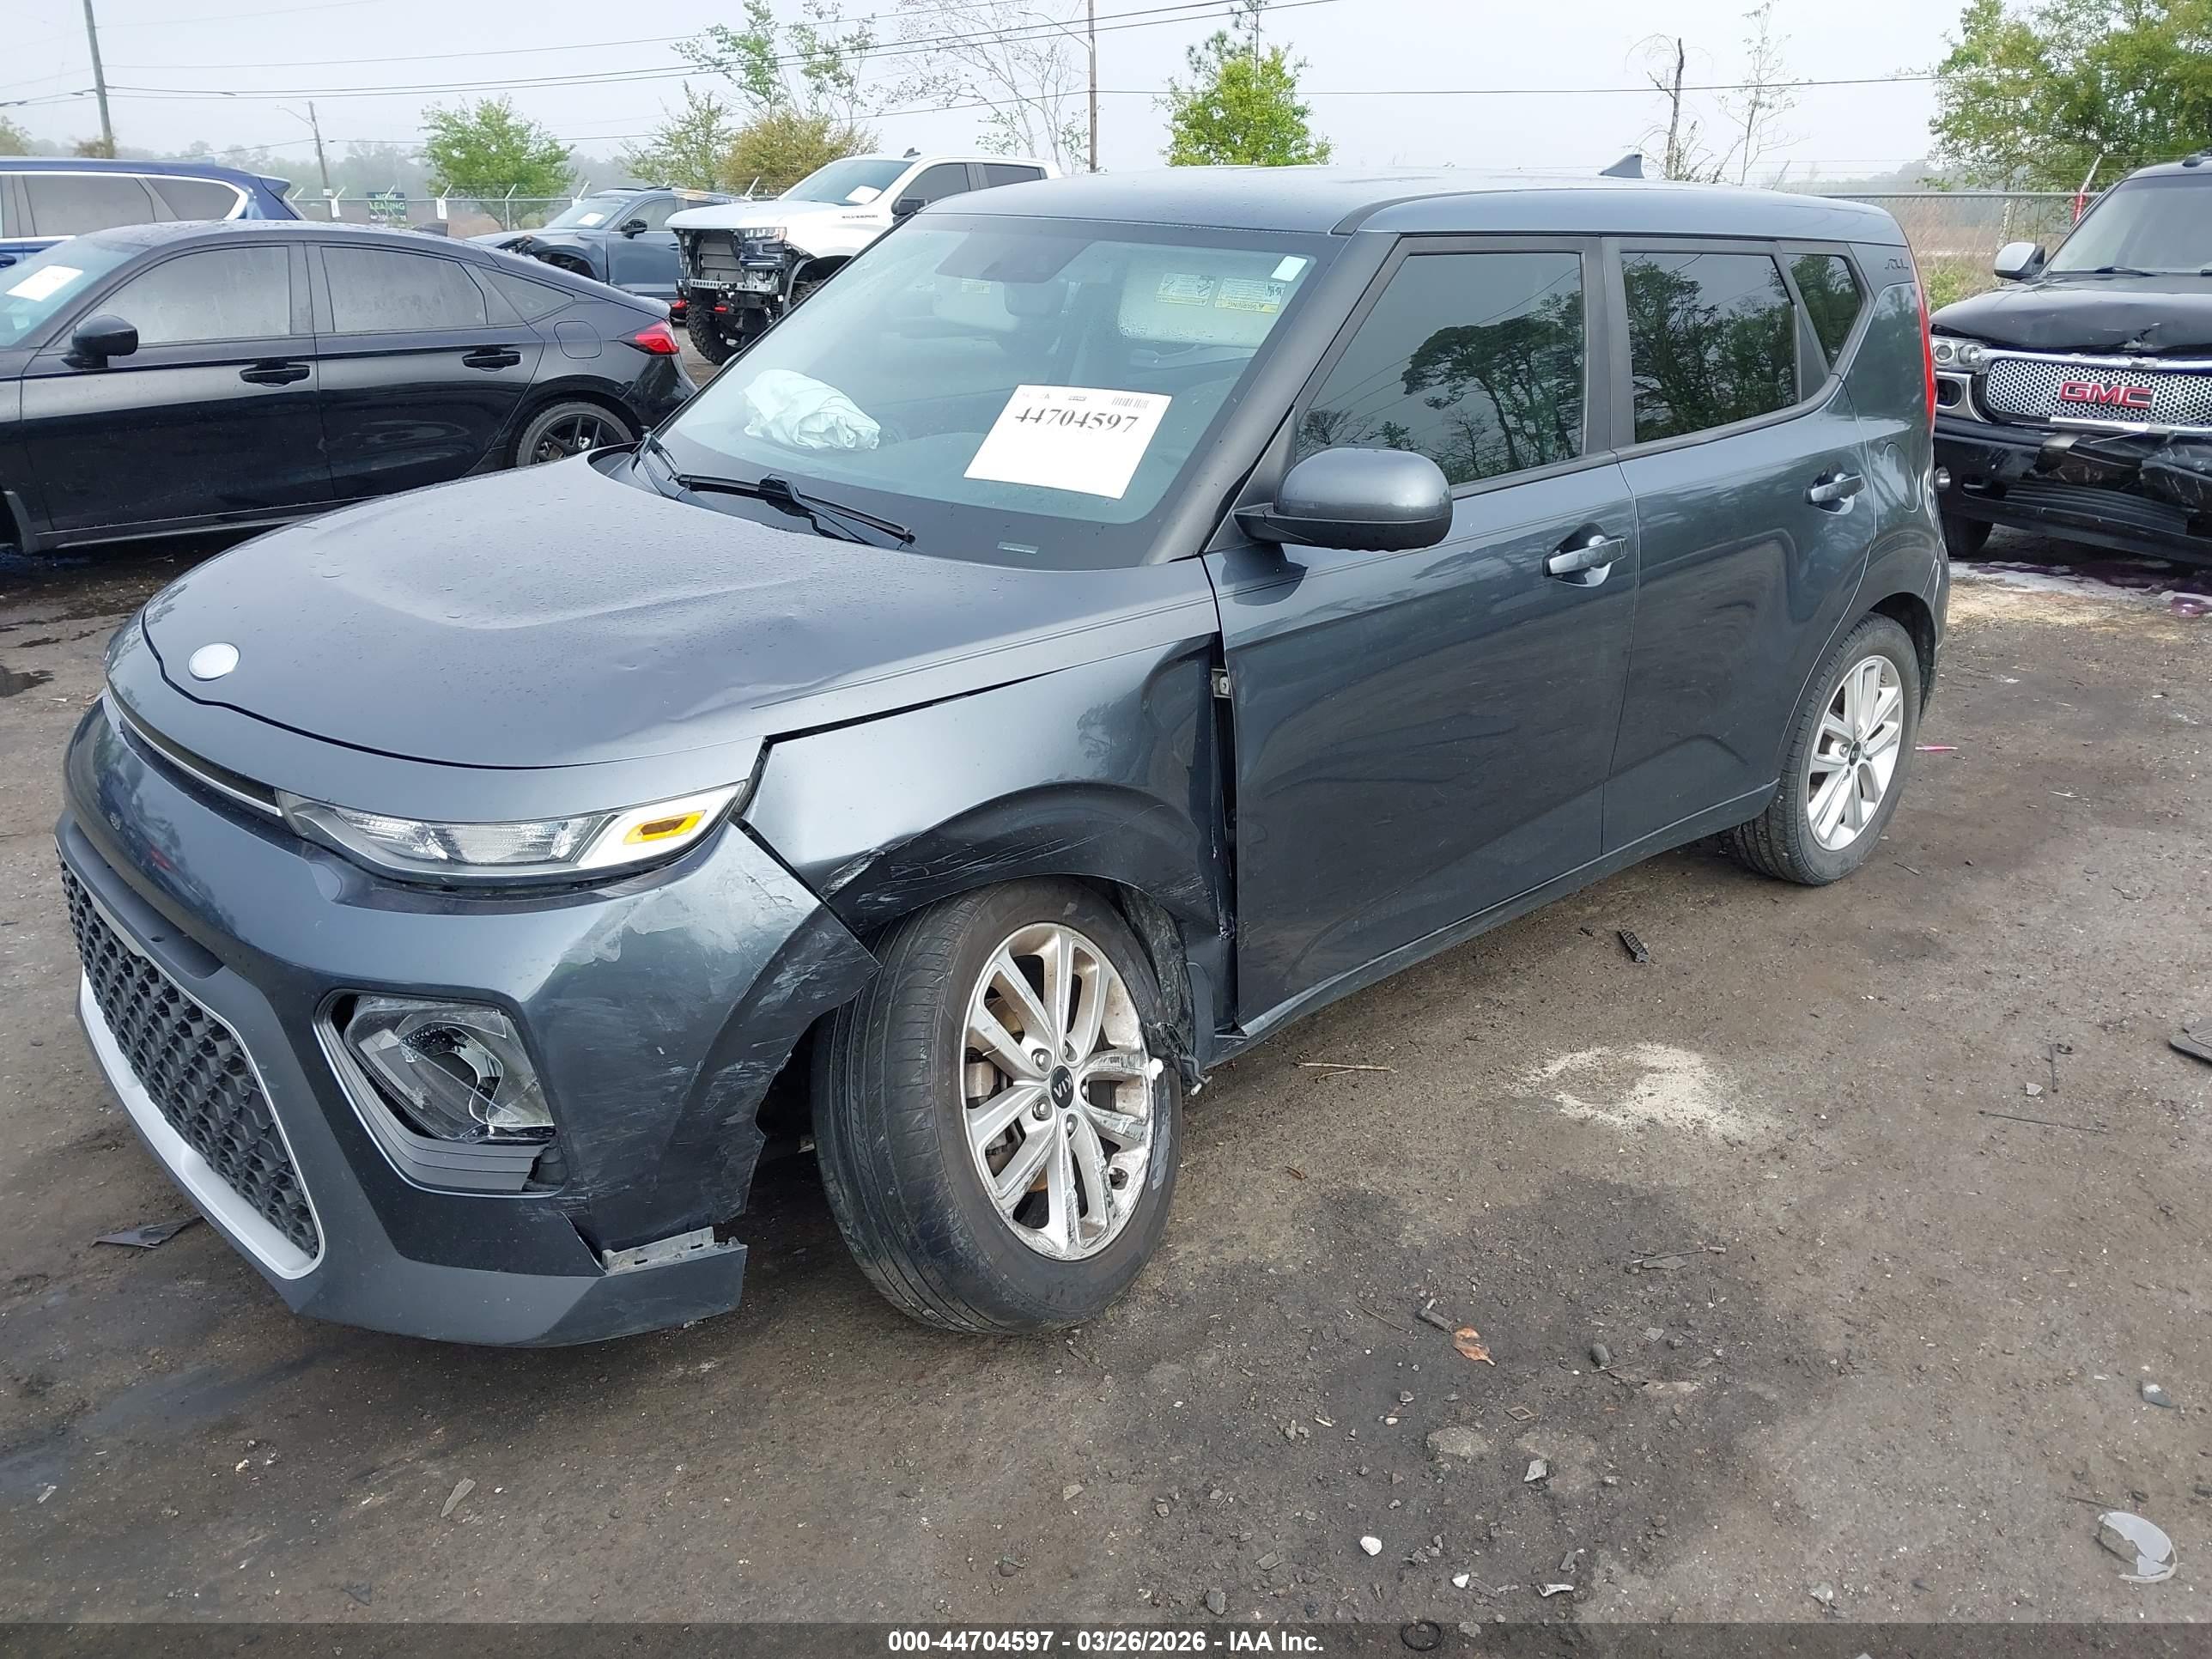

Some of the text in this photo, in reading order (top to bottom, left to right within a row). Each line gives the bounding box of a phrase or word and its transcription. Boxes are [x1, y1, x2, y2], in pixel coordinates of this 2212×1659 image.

[2060, 380, 2154, 409] GMC
[1015, 406, 1139, 433] 44704597
[1053, 1074, 1073, 1098] KIA
